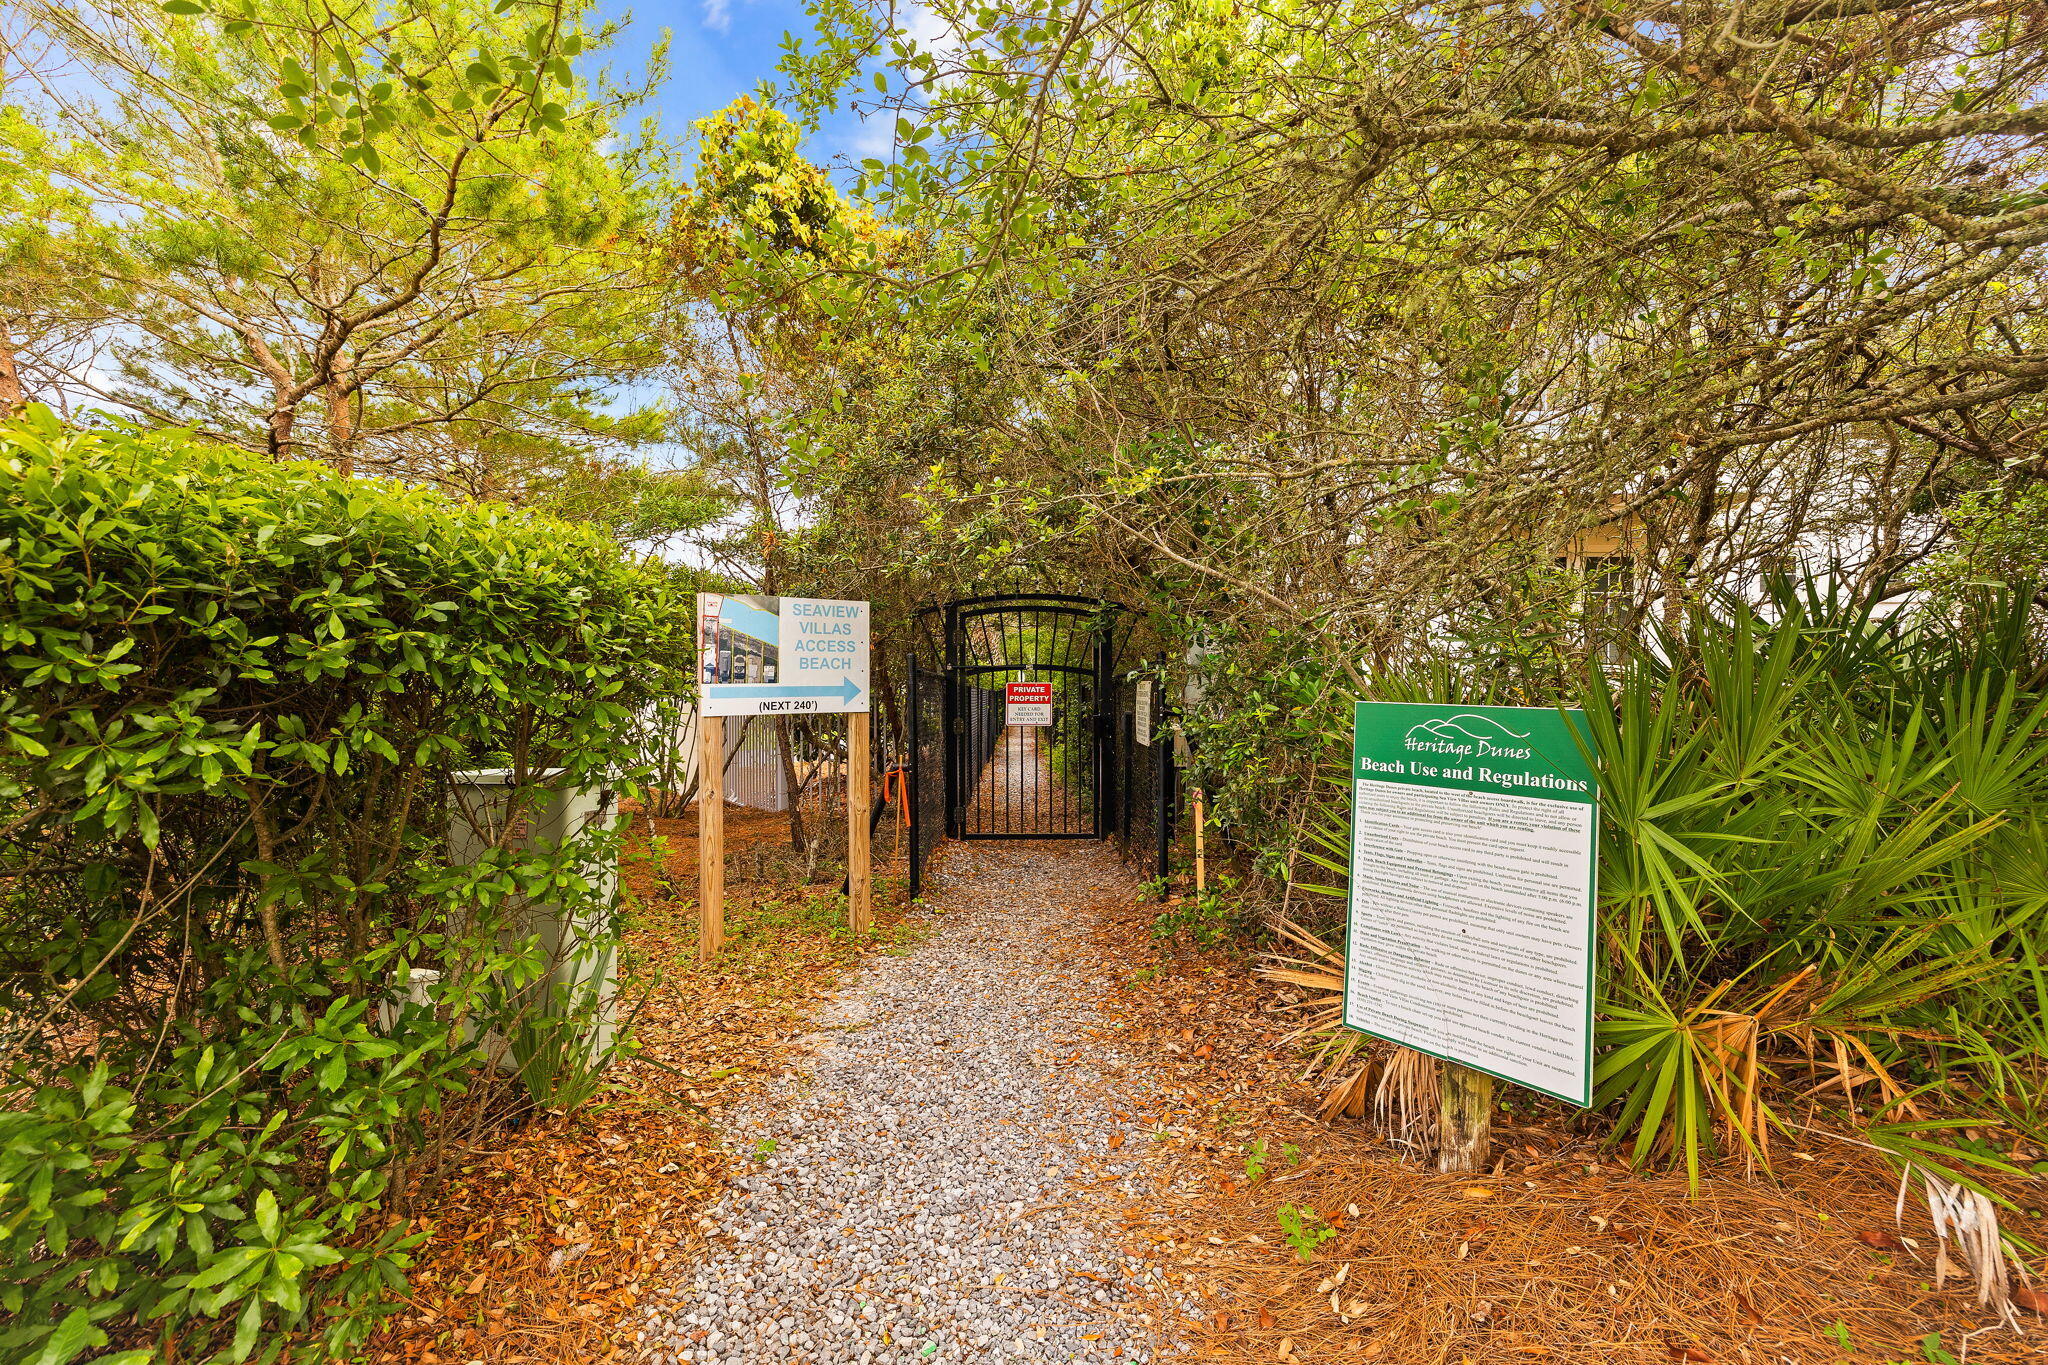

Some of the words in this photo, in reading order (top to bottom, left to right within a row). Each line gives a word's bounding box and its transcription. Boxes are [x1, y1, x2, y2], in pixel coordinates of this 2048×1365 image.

[793, 604, 859, 618] SEAVIEW
[800, 622, 851, 635] VILLAS
[795, 640, 856, 652] ACCESS
[800, 658, 851, 669] BEACH
[759, 701, 791, 713] (NEXT
[794, 701, 818, 711] 240')
[1405, 738, 1472, 763] Heritage
[1476, 740, 1530, 759] Dunes
[1361, 757, 1404, 774] Beach
[1410, 762, 1438, 778] Use
[1443, 766, 1473, 781] and
[1479, 768, 1588, 792] Regulations
